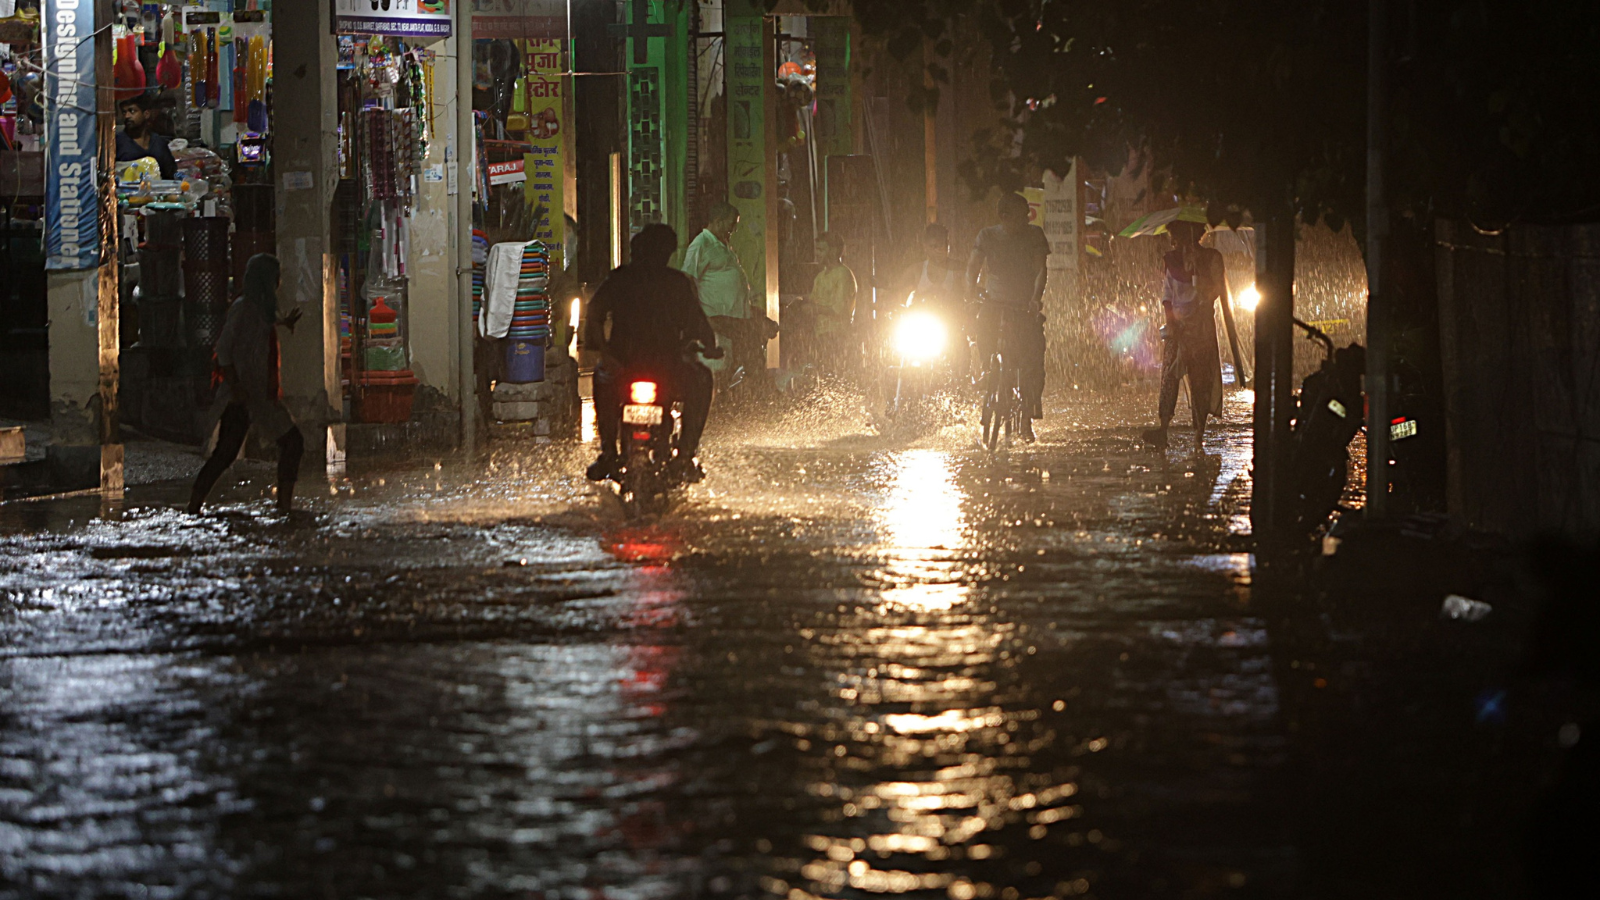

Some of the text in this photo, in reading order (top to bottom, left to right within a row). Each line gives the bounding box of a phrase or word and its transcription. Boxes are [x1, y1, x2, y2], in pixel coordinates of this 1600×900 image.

[54, 0, 80, 108] Designing
[526, 53, 559, 73] पूजा
[59, 113, 81, 155] and
